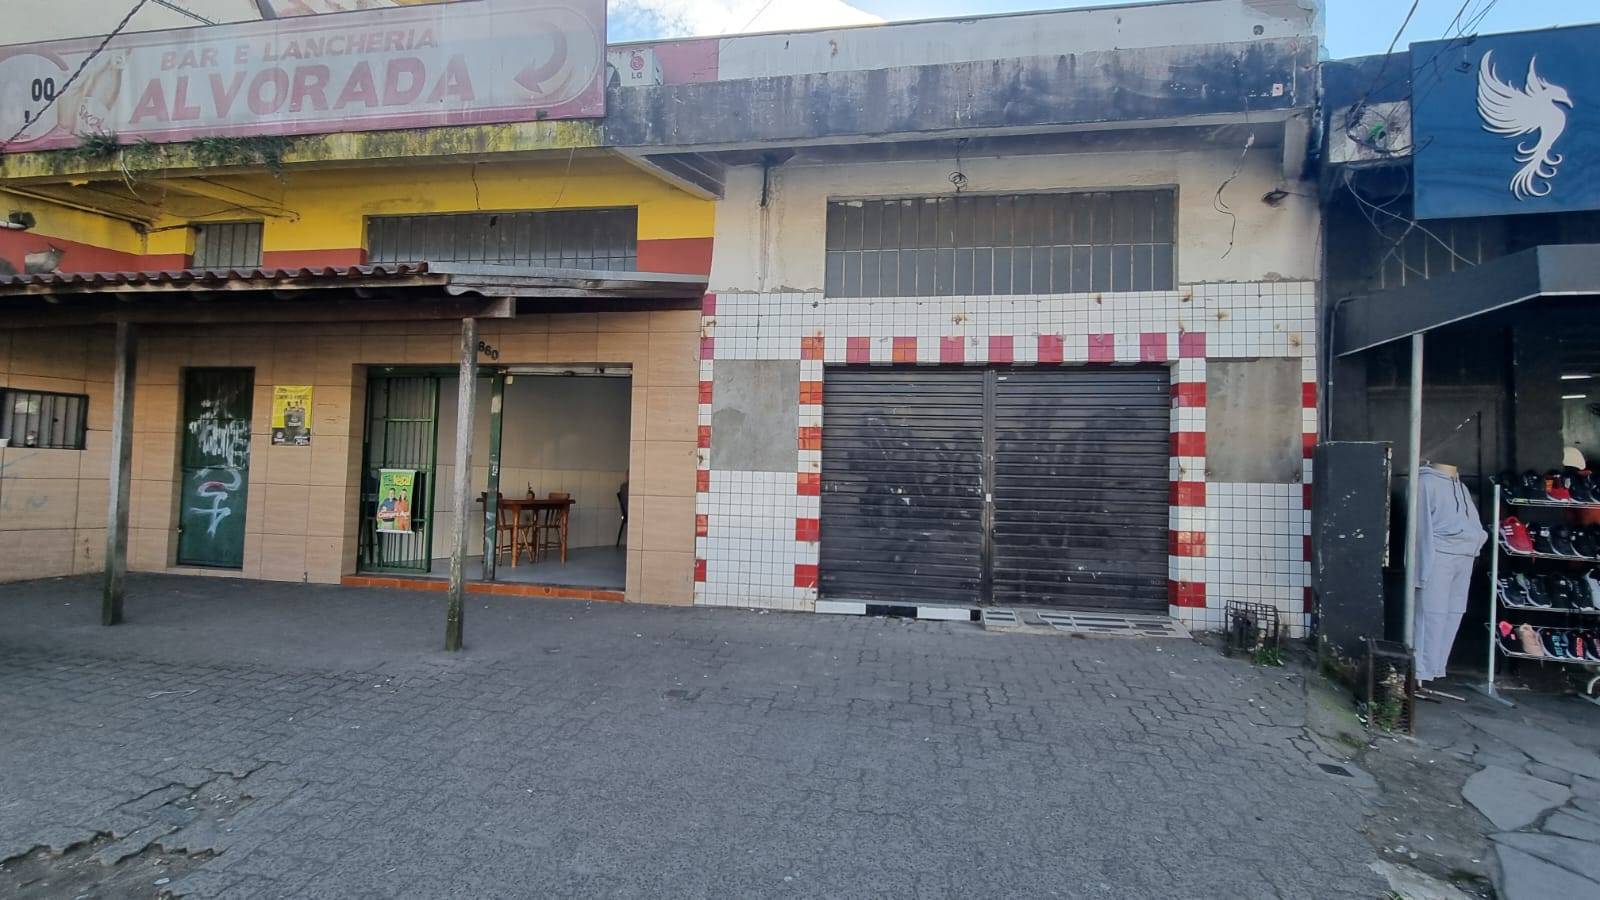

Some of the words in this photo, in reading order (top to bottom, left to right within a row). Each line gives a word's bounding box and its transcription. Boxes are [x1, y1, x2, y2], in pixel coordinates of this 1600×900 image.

[160, 47, 219, 71] BAR
[234, 44, 250, 65] E
[263, 28, 436, 62] LANCHERIA
[129, 53, 475, 124] ALVORADA
